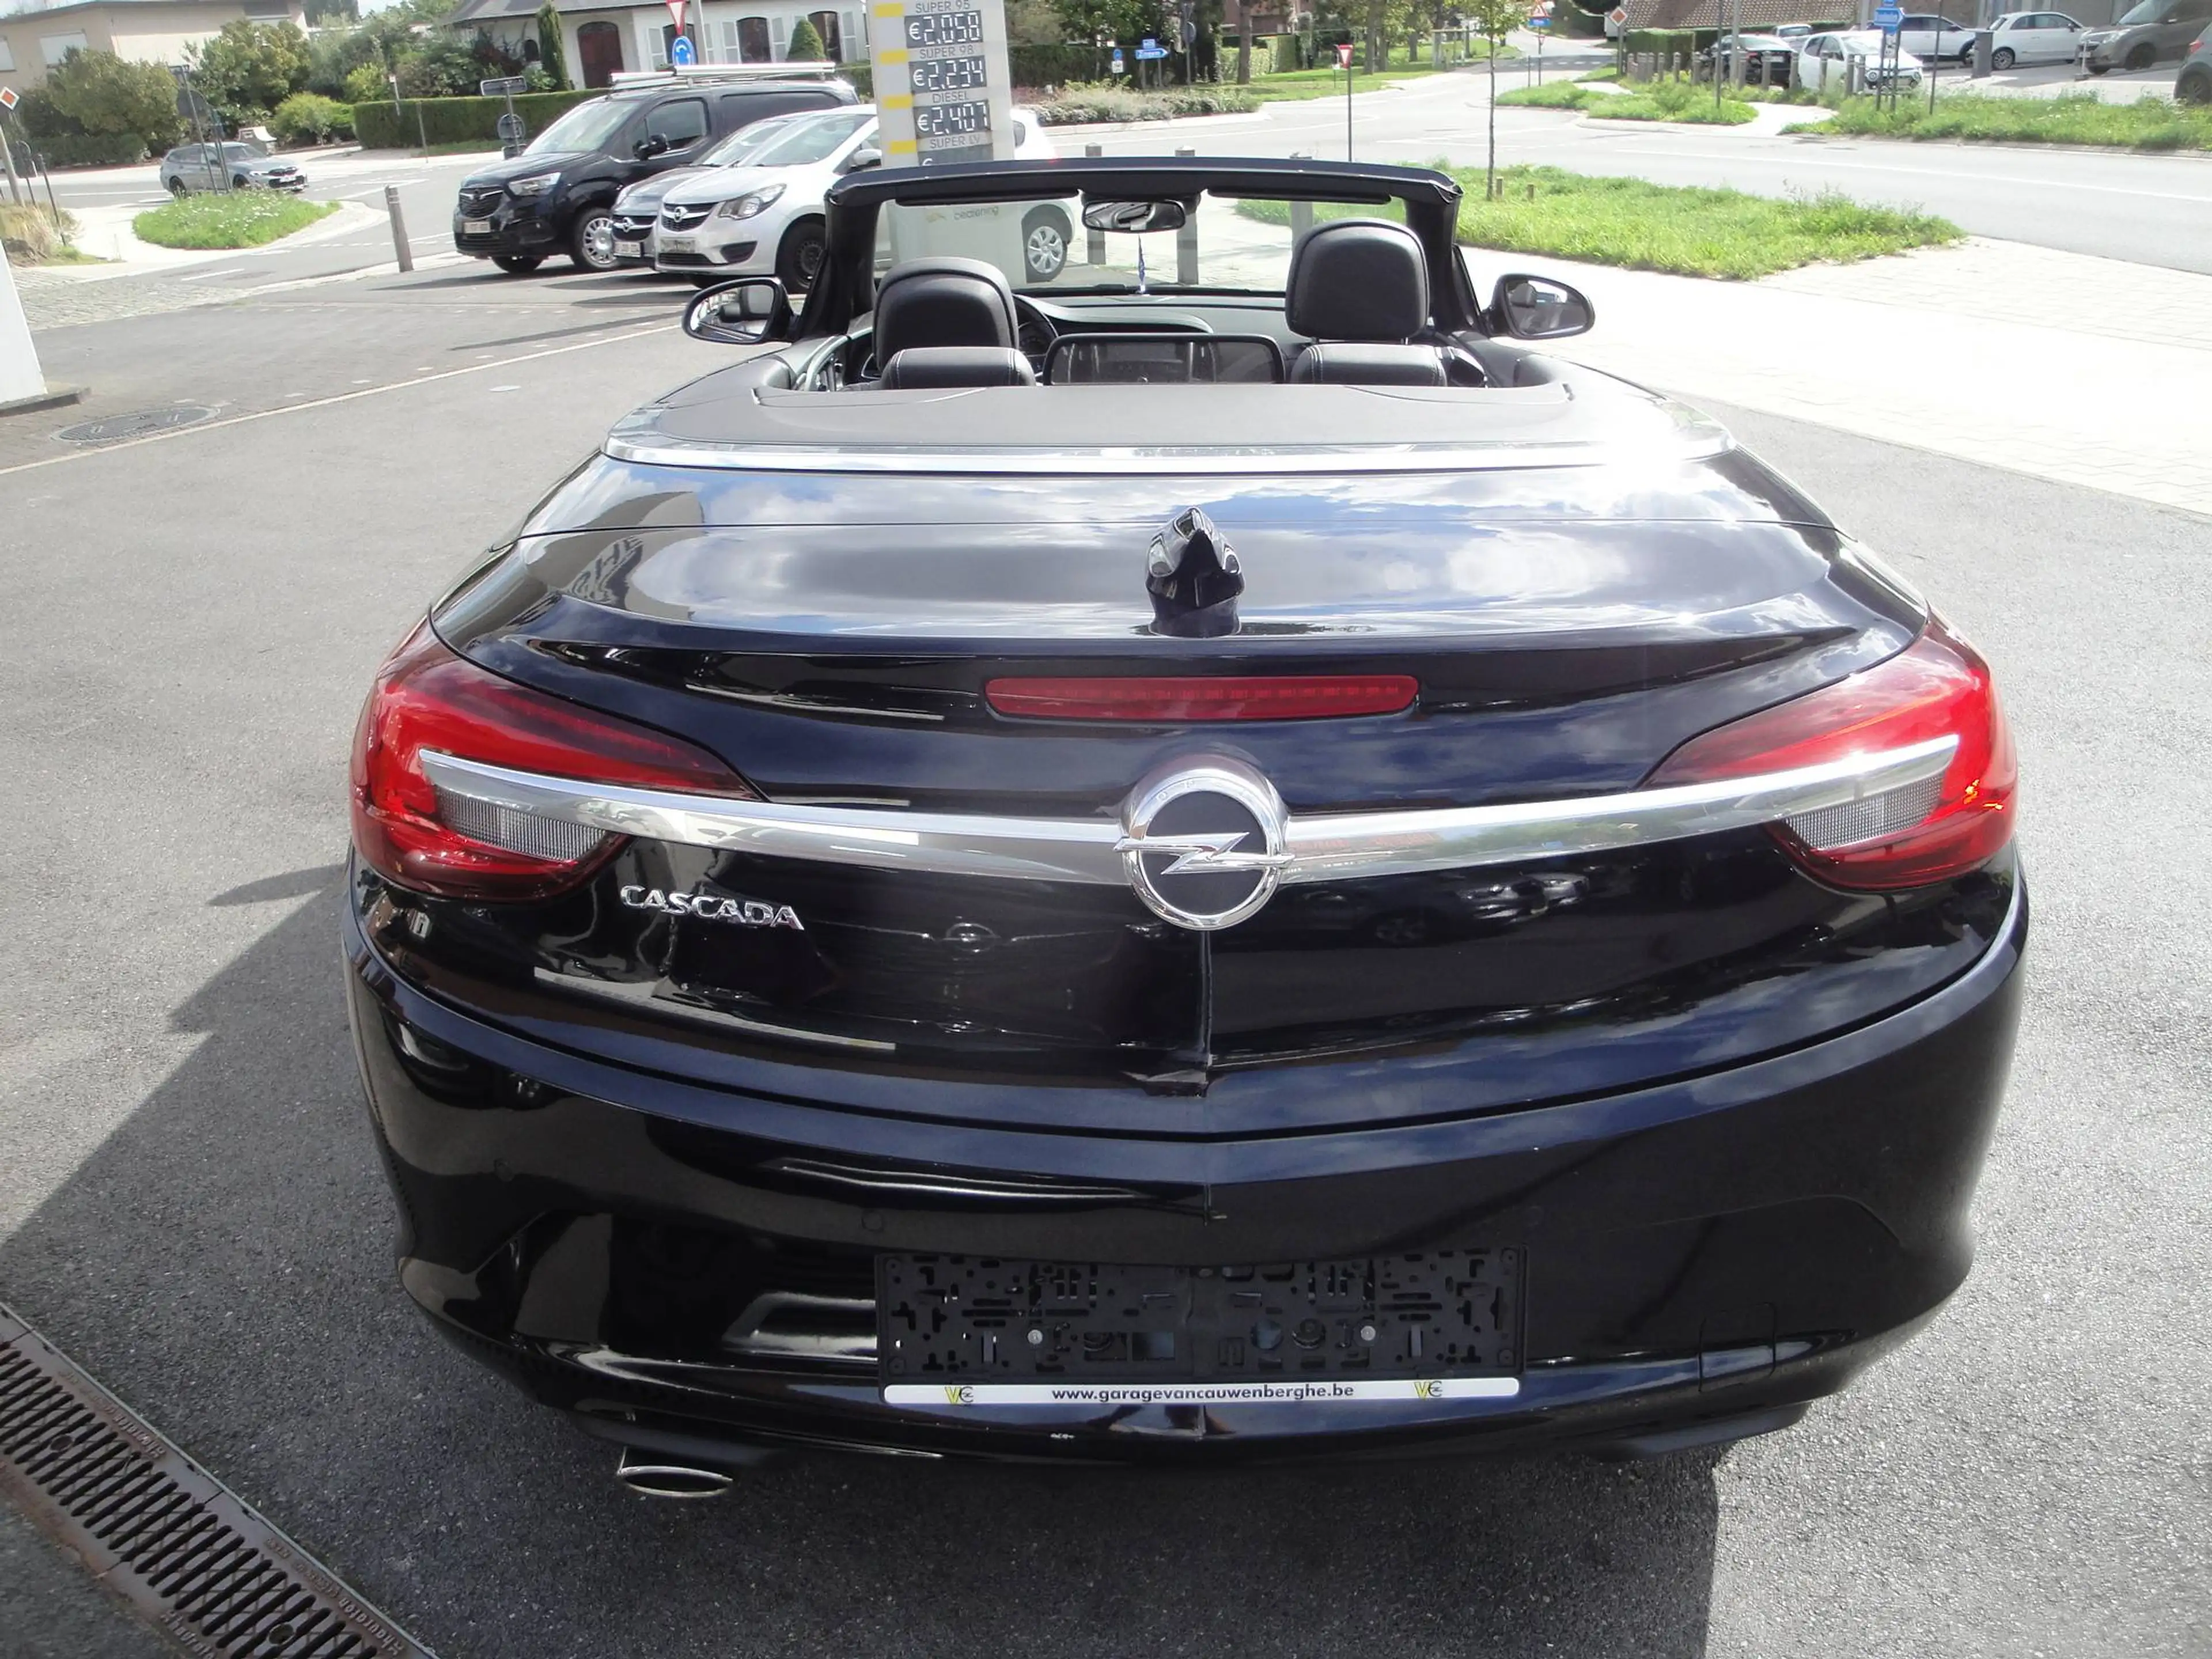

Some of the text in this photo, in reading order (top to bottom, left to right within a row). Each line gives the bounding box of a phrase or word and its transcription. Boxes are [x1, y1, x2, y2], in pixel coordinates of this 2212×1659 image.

[915, 0, 971, 13] SUPER 95
[920, 45, 974, 59] SUPER 98
[932, 92, 969, 104] DIESEL
[930, 136, 965, 149] SUPER
[620, 885, 805, 931] CASCADA
[1052, 1383, 1355, 1403] www.garagevancauwenberghe.be
[339, 1597, 395, 1649] hauraton
[166, 1614, 217, 1659] haurato
